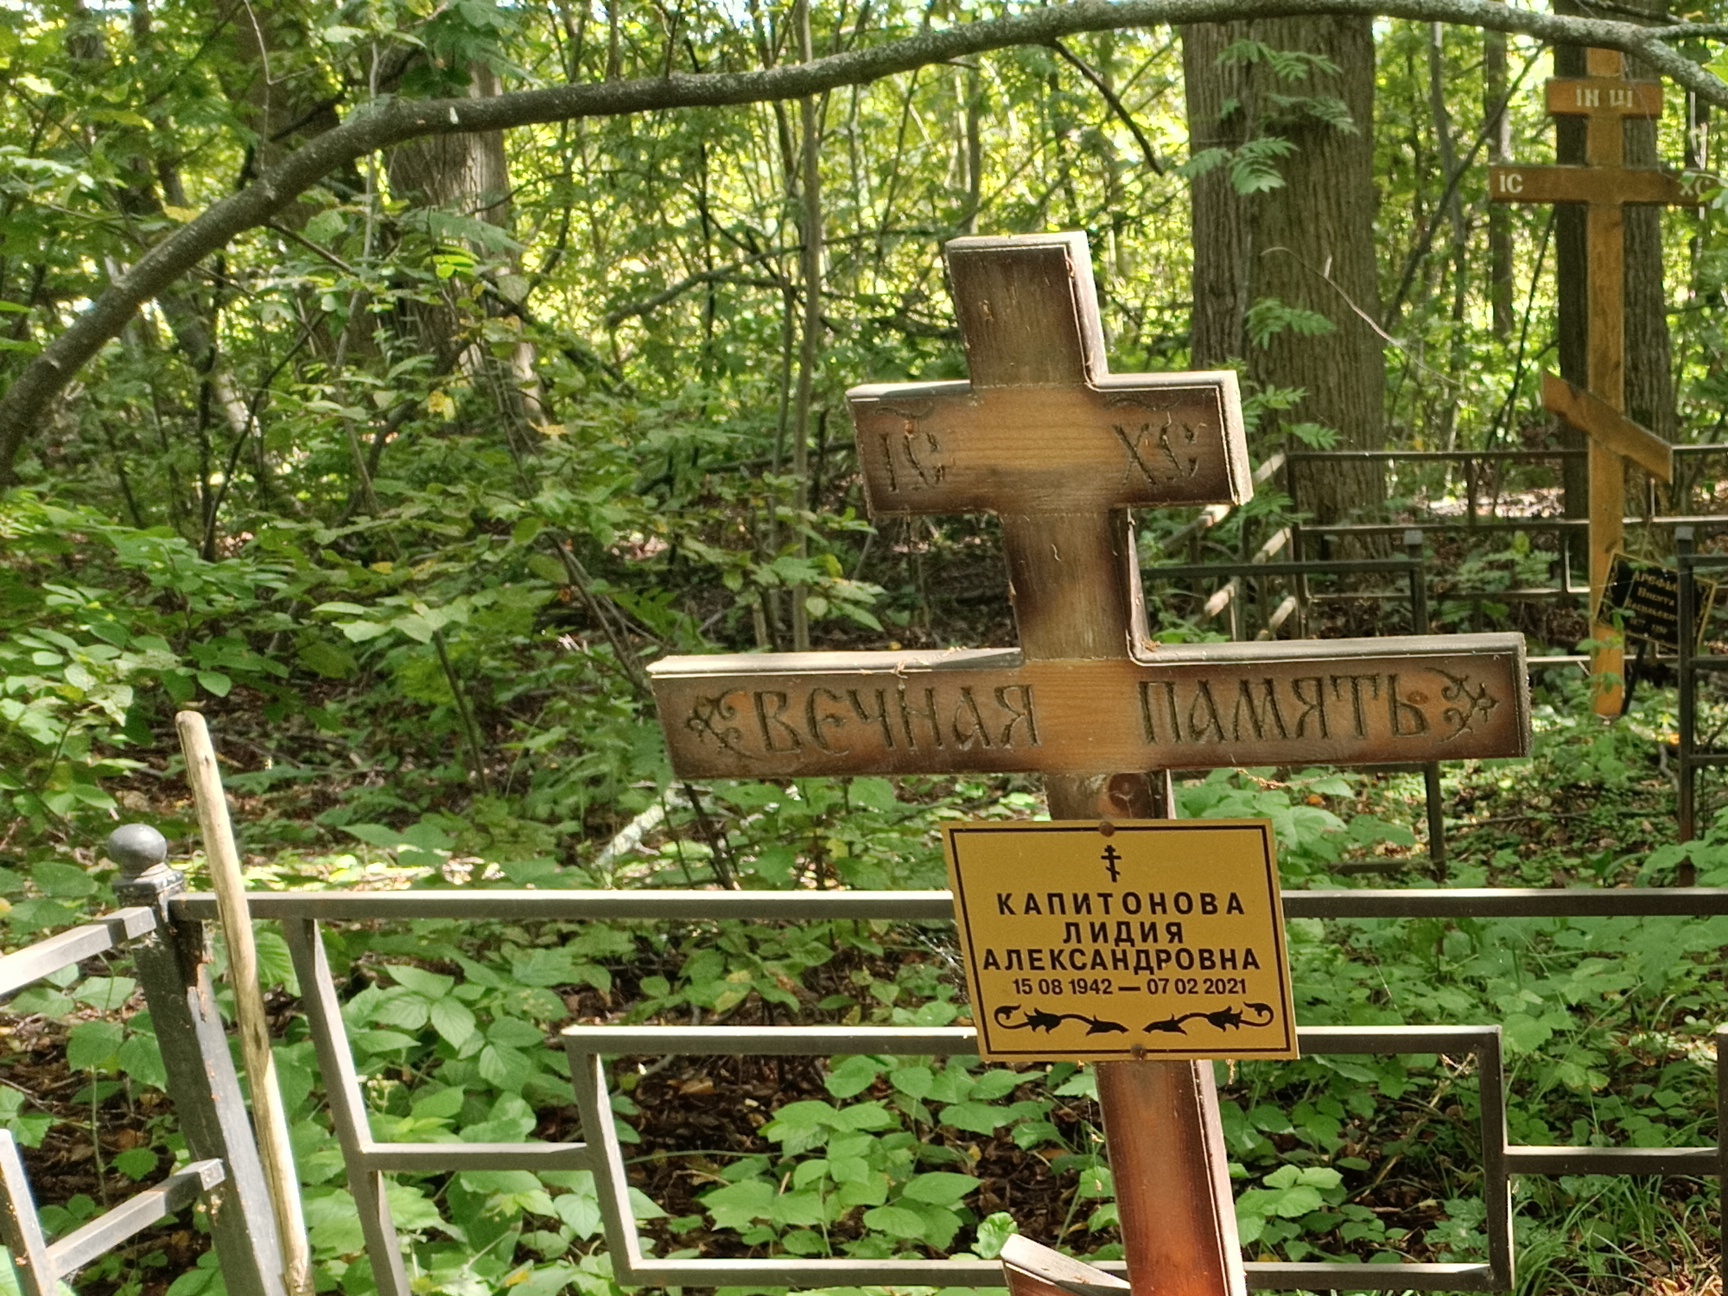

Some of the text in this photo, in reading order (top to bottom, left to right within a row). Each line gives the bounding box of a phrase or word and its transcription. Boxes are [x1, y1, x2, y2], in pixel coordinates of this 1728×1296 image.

[753, 672, 1430, 755] ВЕЧНАЯ ПАМЯТЬ
[996, 891, 1245, 915] КАПИТОНОВА
[1062, 920, 1184, 947] ЛИДИЯ
[982, 948, 1261, 975] АЛЕКСАНДРОВНА
[1012, 978, 1033, 995] 15
[1038, 978, 1063, 995] 08
[1068, 978, 1113, 995] 1942
[1147, 978, 1169, 995] 07
[1175, 978, 1198, 995] 02
[1203, 978, 1247, 995] 2021
